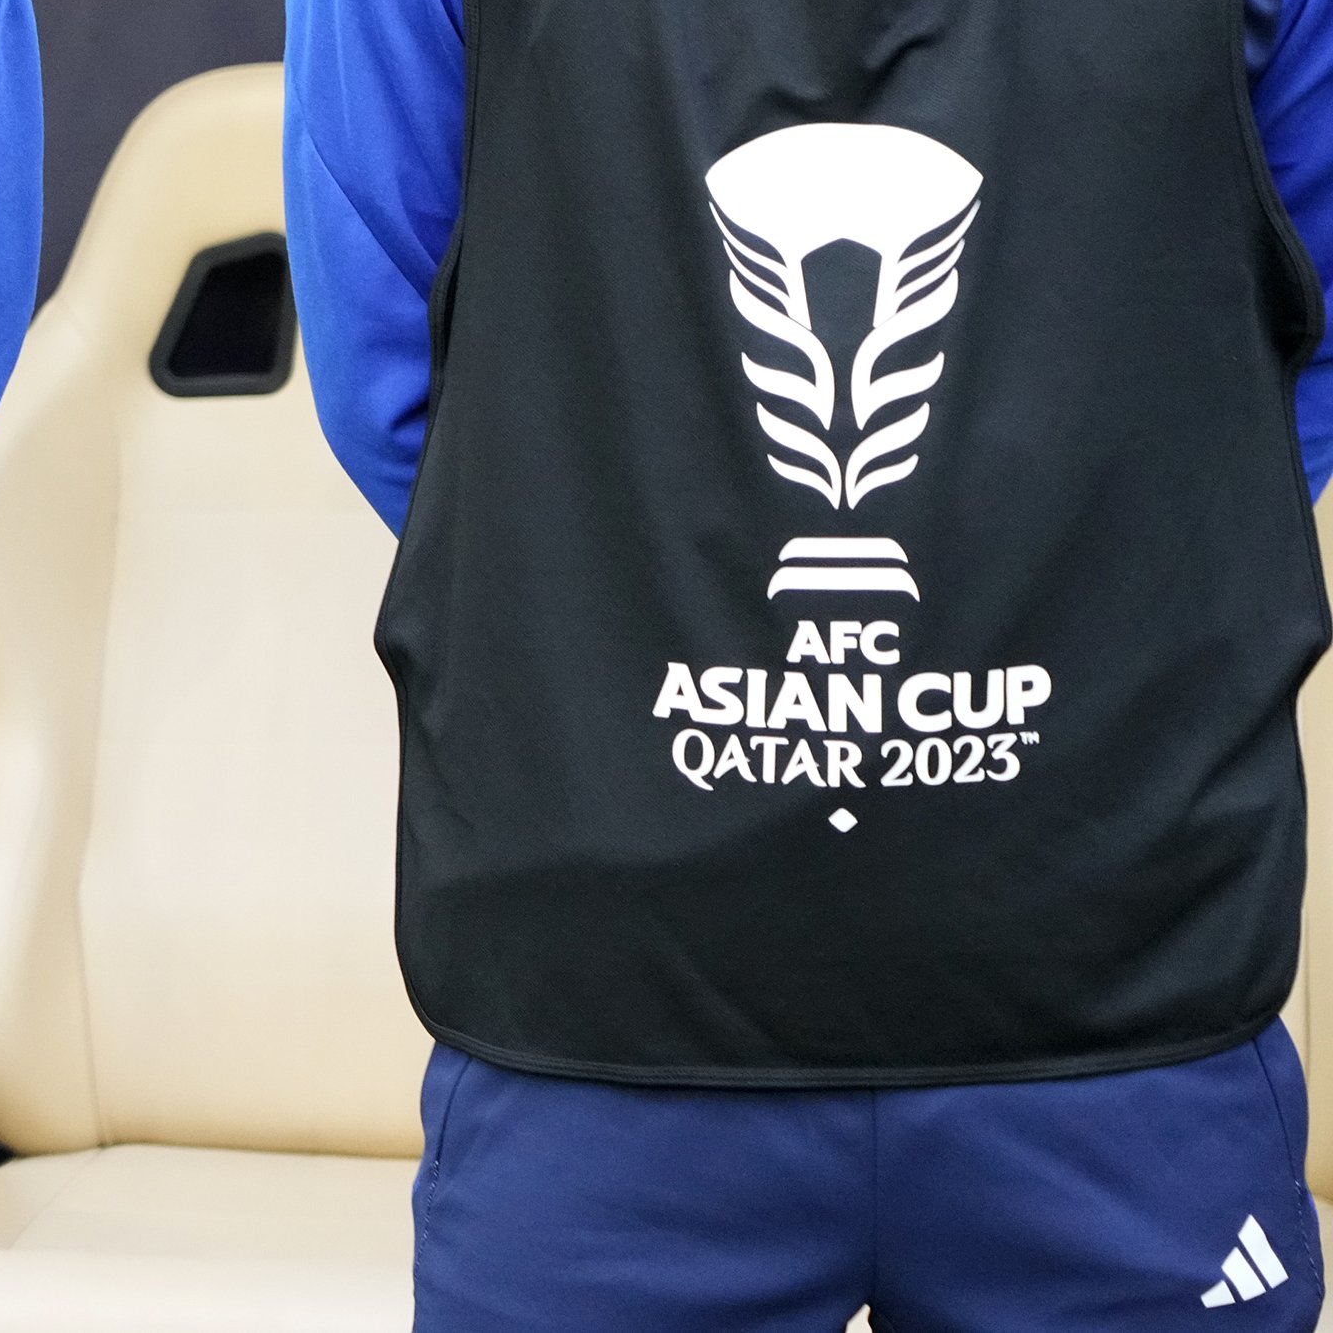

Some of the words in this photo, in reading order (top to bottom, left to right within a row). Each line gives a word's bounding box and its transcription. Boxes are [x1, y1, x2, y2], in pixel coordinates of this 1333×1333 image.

[785, 619, 901, 666] AFC
[651, 661, 883, 734] ASIAN
[896, 664, 1052, 733] CUP
[671, 728, 867, 792] QATAR
